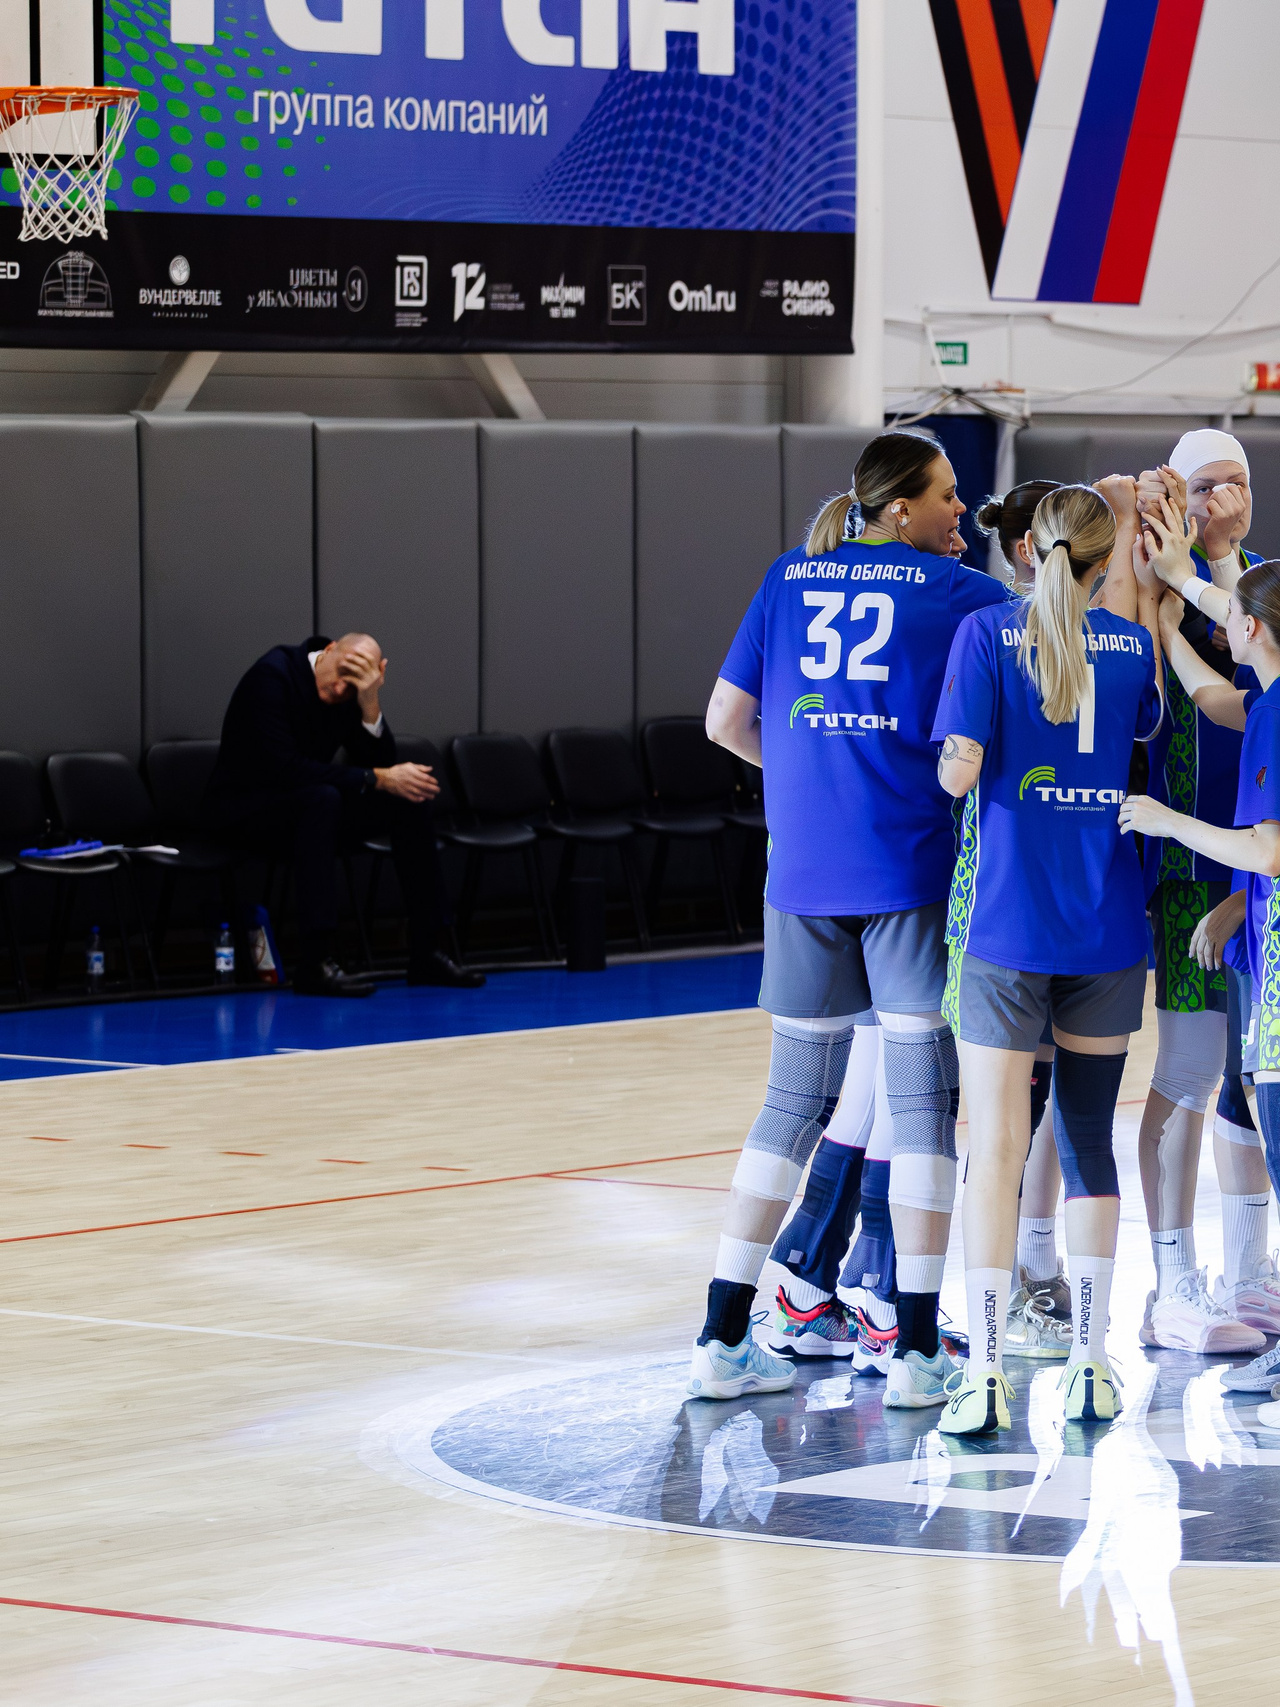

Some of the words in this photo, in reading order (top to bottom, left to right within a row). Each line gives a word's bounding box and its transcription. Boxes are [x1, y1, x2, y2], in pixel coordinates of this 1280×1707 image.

[253, 90, 374, 135] группа
[384, 93, 547, 136] компаний
[289, 268, 338, 289] ЦВЕТЫ
[783, 280, 830, 298] РАДИО
[139, 288, 222, 308] ВУНДЕРВЕЛЛЕ
[256, 289, 338, 308] ЯБЛОНЬКИ
[451, 262, 486, 322] 12
[668, 280, 736, 312] Om1.ru
[782, 298, 835, 316] СИБИРЬ
[784, 561, 848, 581] ОМСКАЯ
[850, 563, 926, 584] ОБЛАСТЬ
[800, 591, 895, 682] 32
